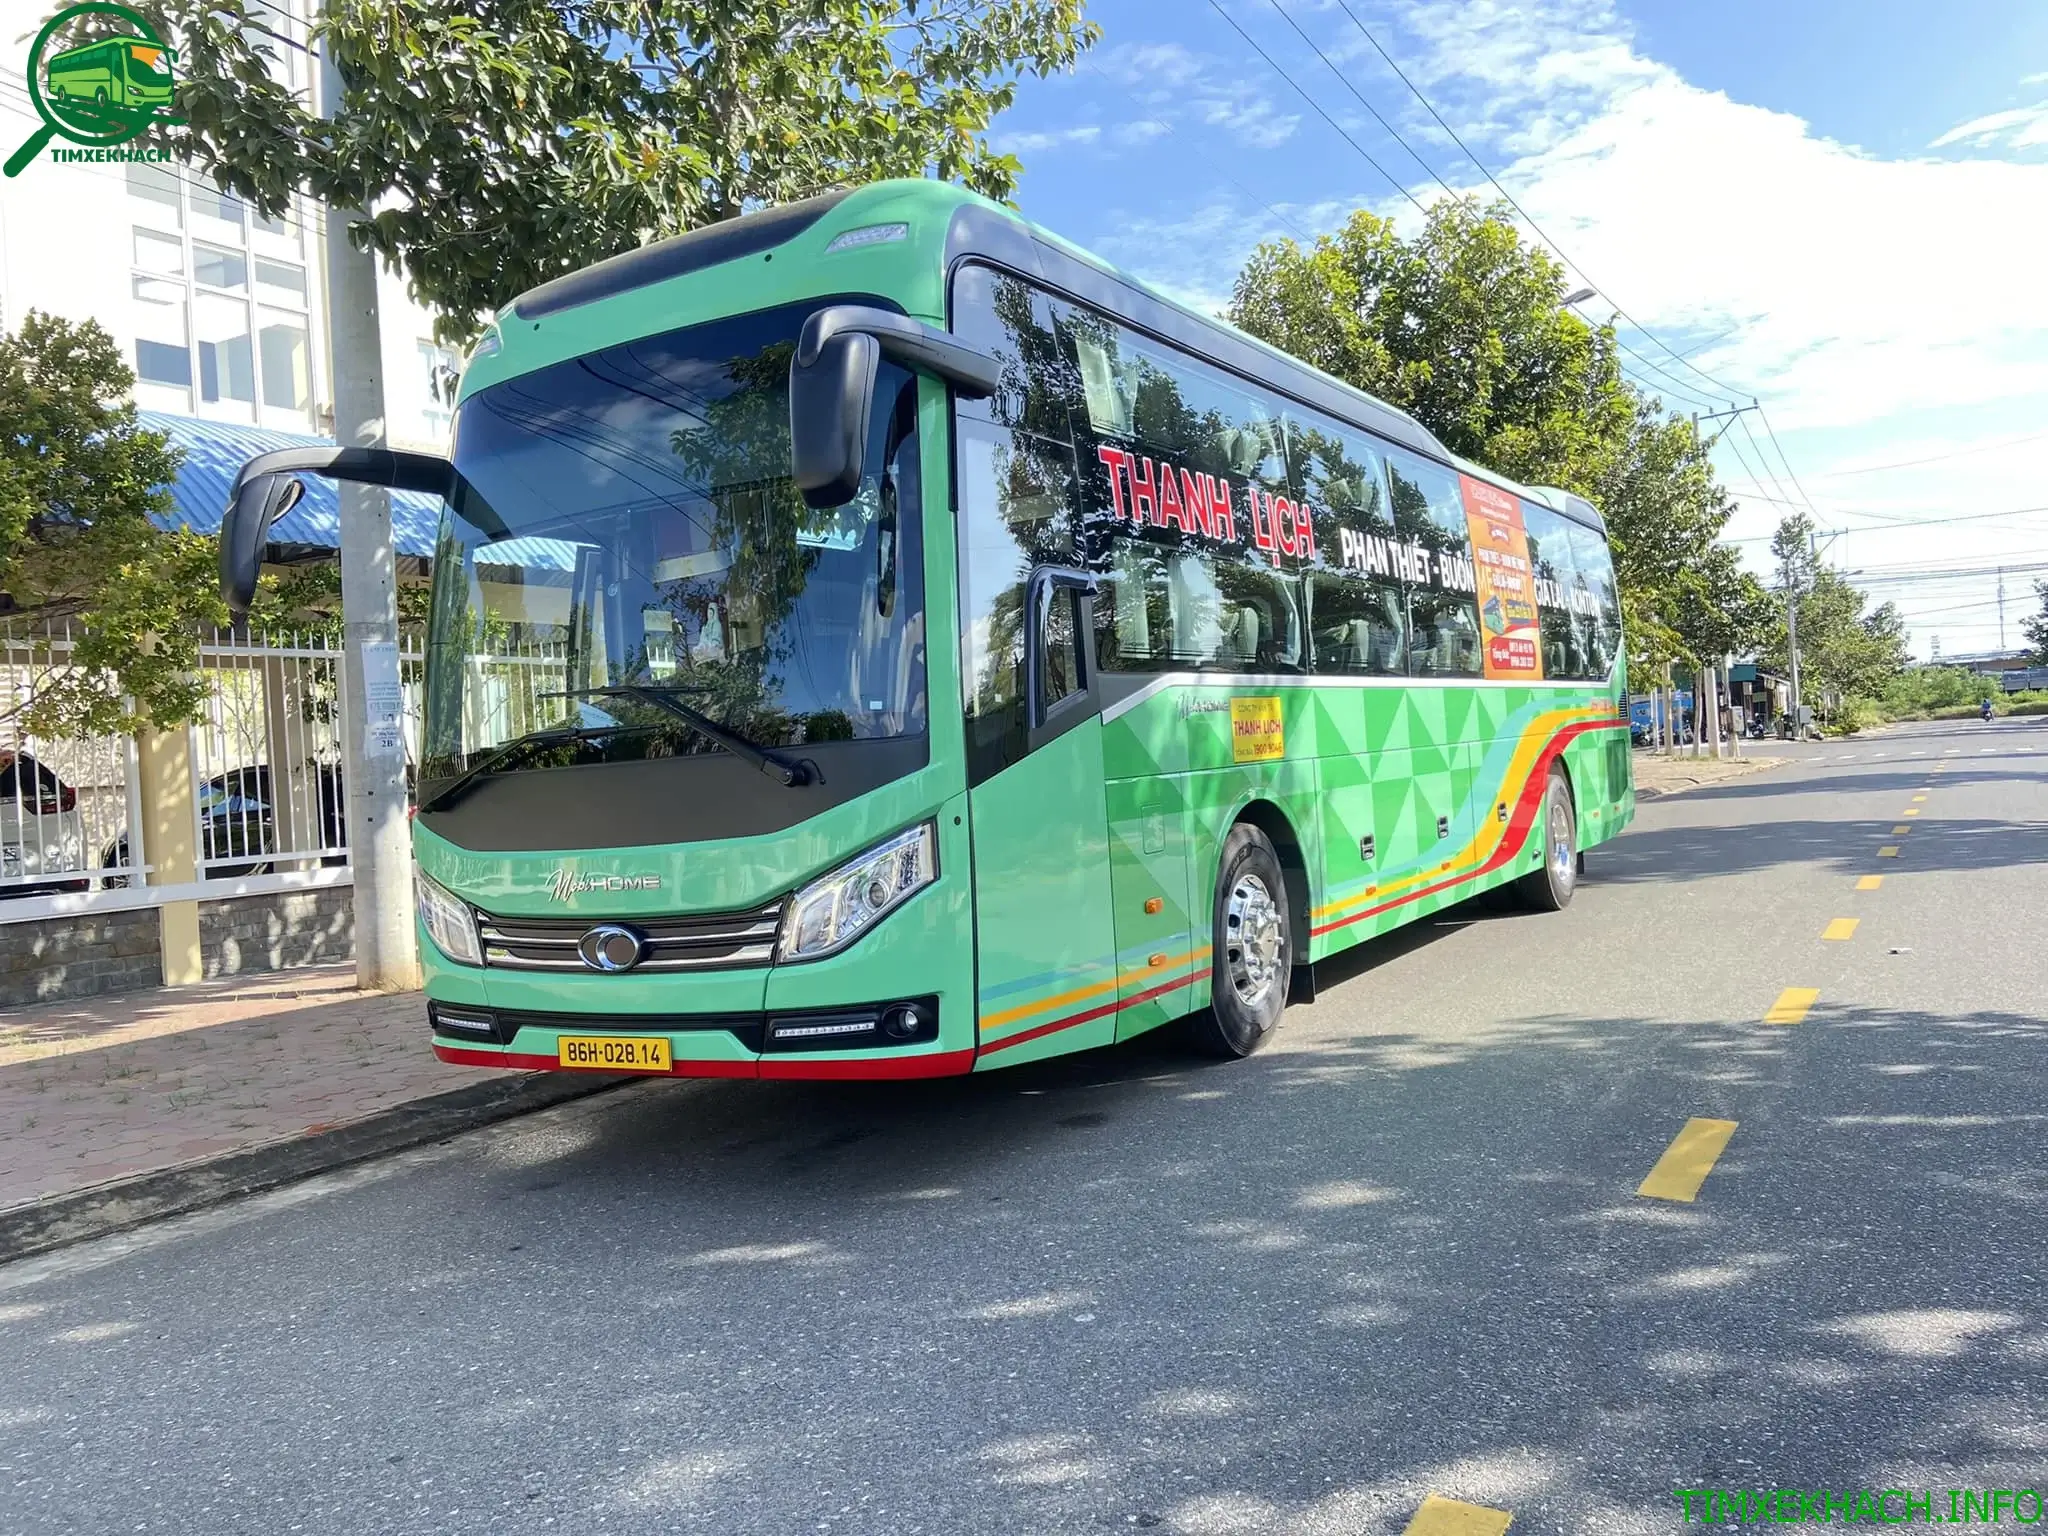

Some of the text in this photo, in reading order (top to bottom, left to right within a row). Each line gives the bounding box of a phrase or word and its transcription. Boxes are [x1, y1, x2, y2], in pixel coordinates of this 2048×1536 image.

[1097, 445, 1316, 568] THANH LỊCH
[1340, 527, 1389, 576] PHAN
[1387, 533, 1431, 584] THIẾT
[1234, 720, 1261, 736] THANH
[568, 1042, 660, 1064] 86H-028.14
